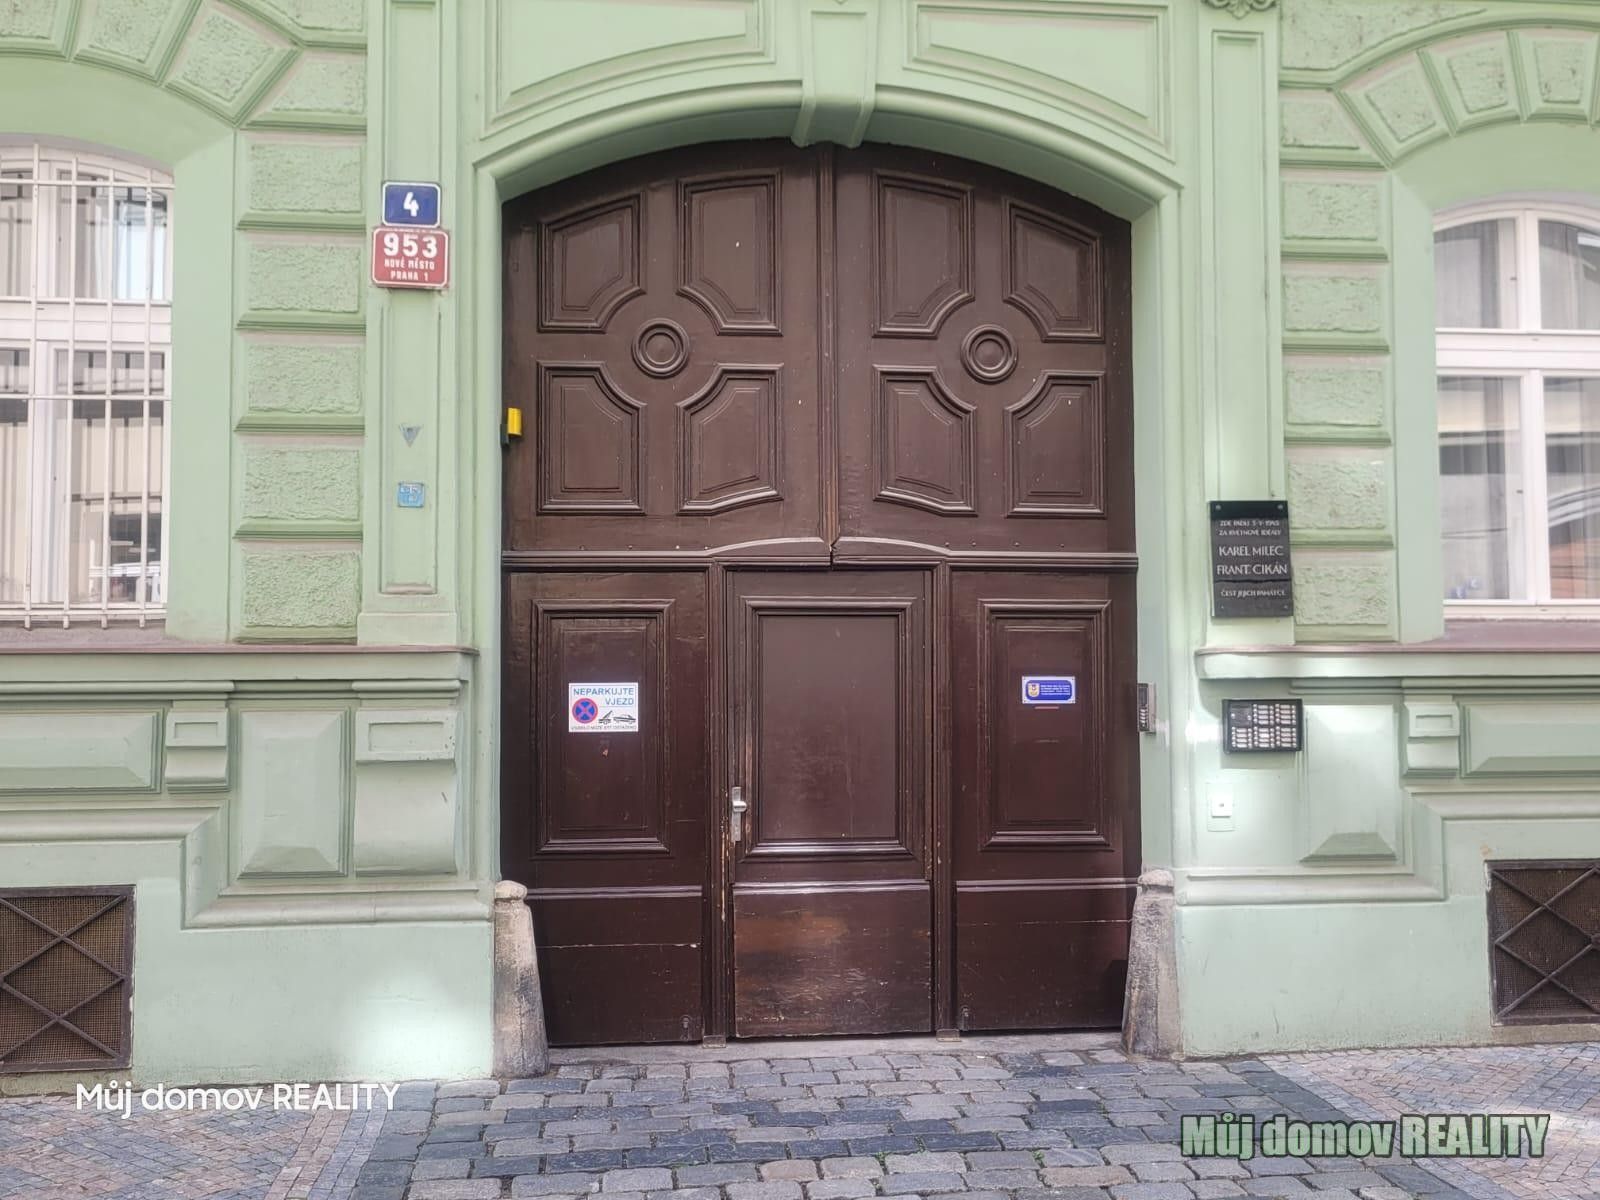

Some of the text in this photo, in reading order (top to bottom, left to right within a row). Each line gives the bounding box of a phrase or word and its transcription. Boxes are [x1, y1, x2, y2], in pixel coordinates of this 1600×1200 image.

[403, 191, 420, 218] 4
[383, 232, 438, 259] 953
[384, 256, 435, 271] NOVÉ MĚSTO
[390, 270, 429, 281] PRAHA 1
[1219, 545, 1284, 556] KAREL MILEC
[1252, 561, 1288, 575] CIKÁN
[573, 687, 635, 696] NEPARKUJTE
[605, 697, 634, 706] VJEZD
